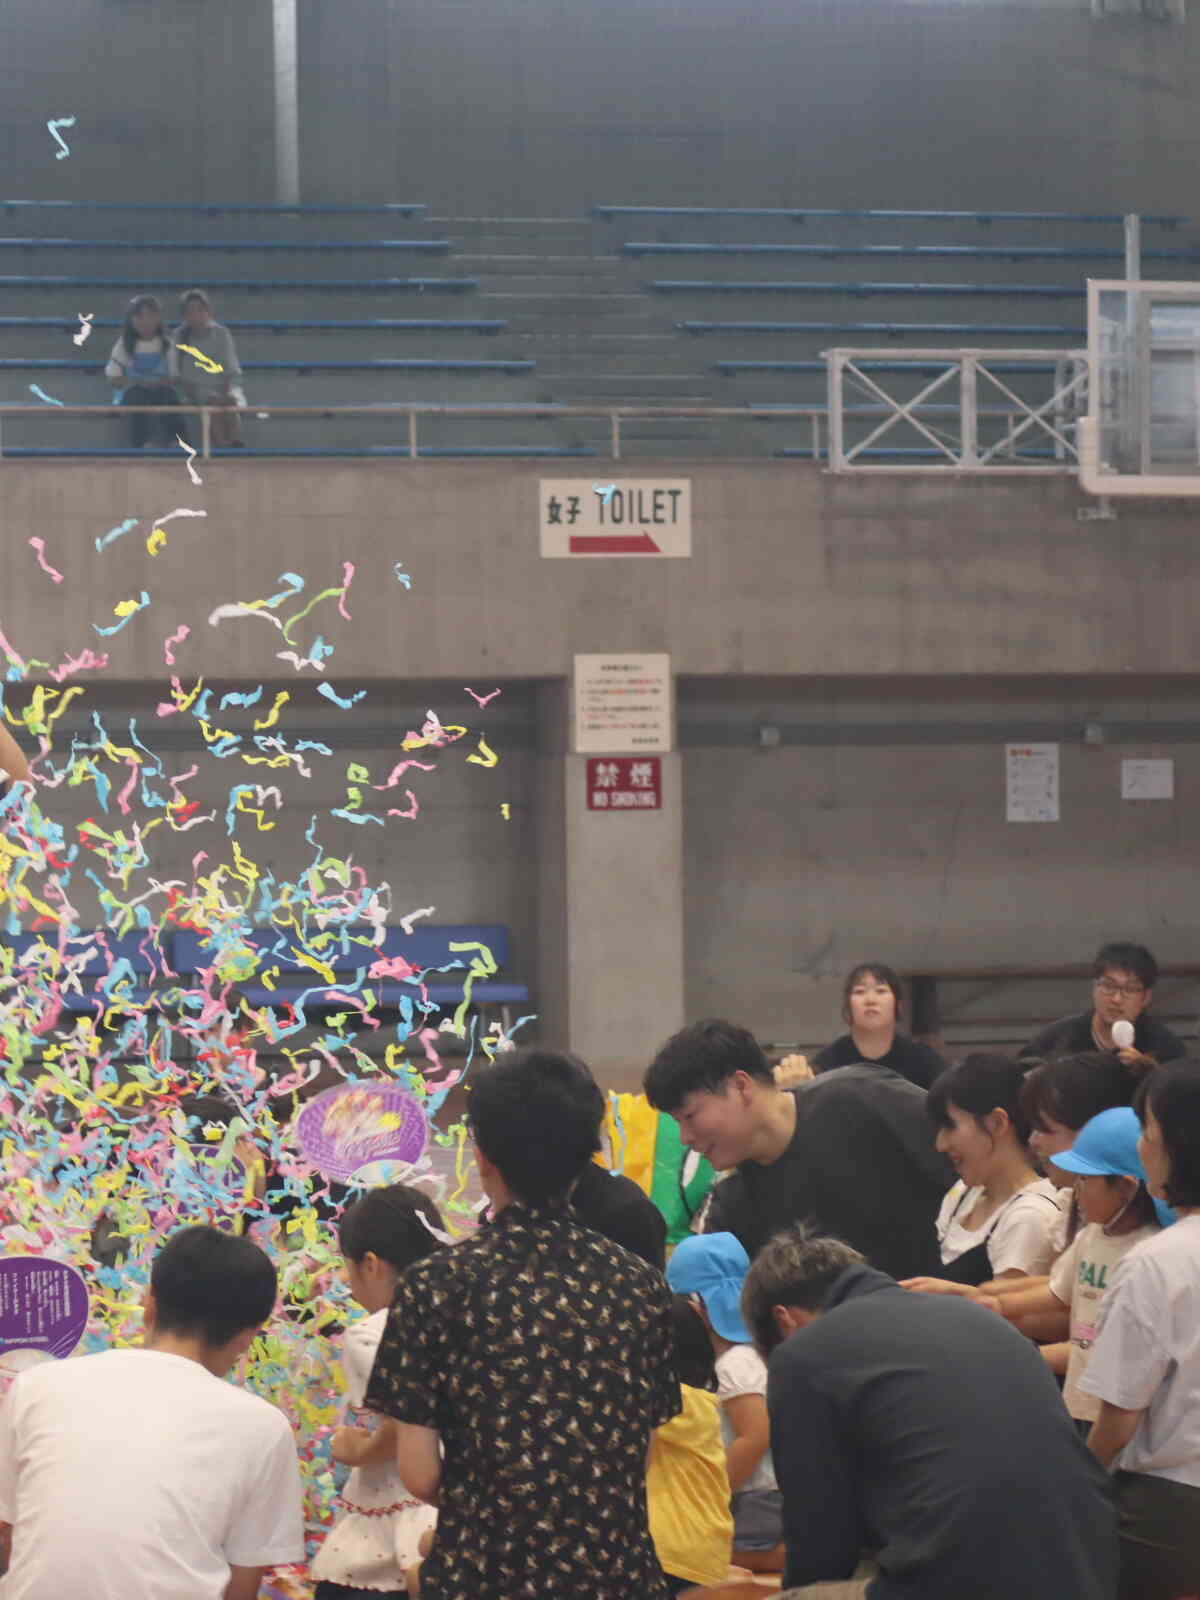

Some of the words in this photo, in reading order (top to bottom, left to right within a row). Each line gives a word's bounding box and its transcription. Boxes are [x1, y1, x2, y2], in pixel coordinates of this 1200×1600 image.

[548, 496, 581, 524] 女子
[595, 489, 681, 524] TOILET
[593, 792, 608, 808] NO
